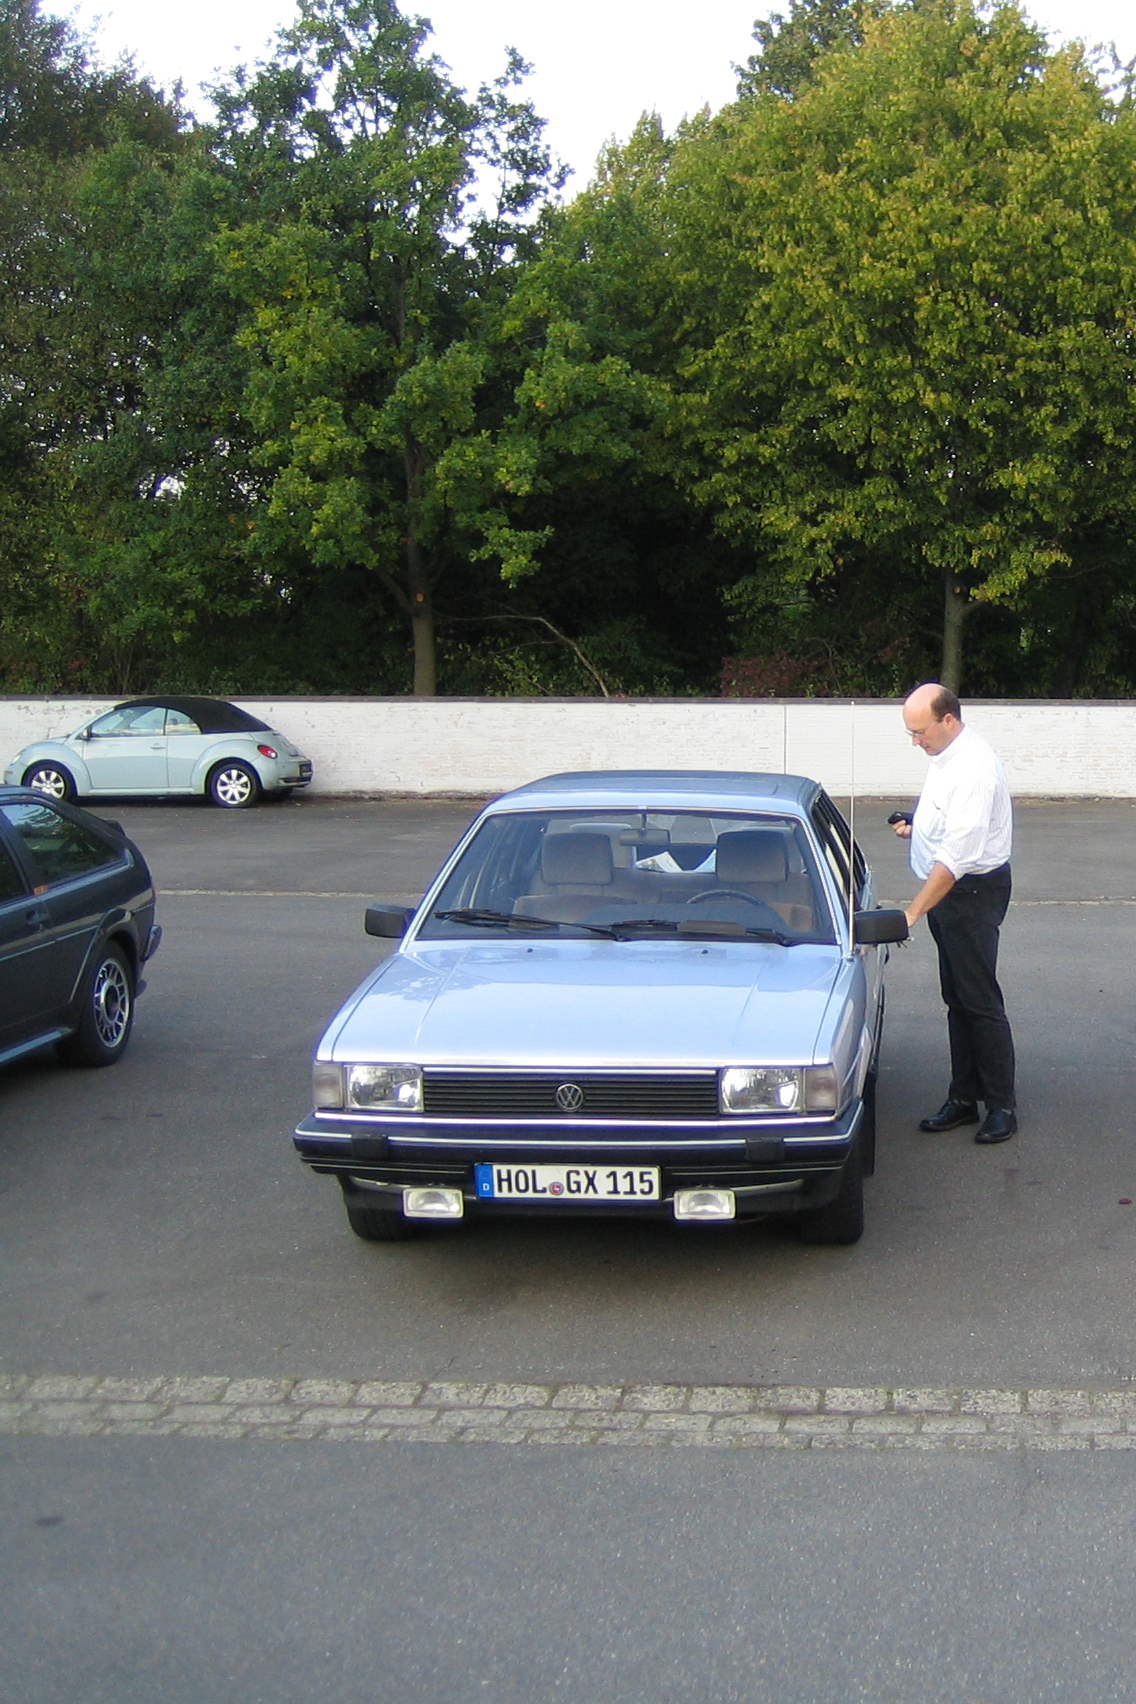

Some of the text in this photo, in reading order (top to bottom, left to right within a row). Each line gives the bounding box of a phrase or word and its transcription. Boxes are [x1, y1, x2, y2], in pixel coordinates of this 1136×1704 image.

[496, 1169, 655, 1196] HOL GX 115
